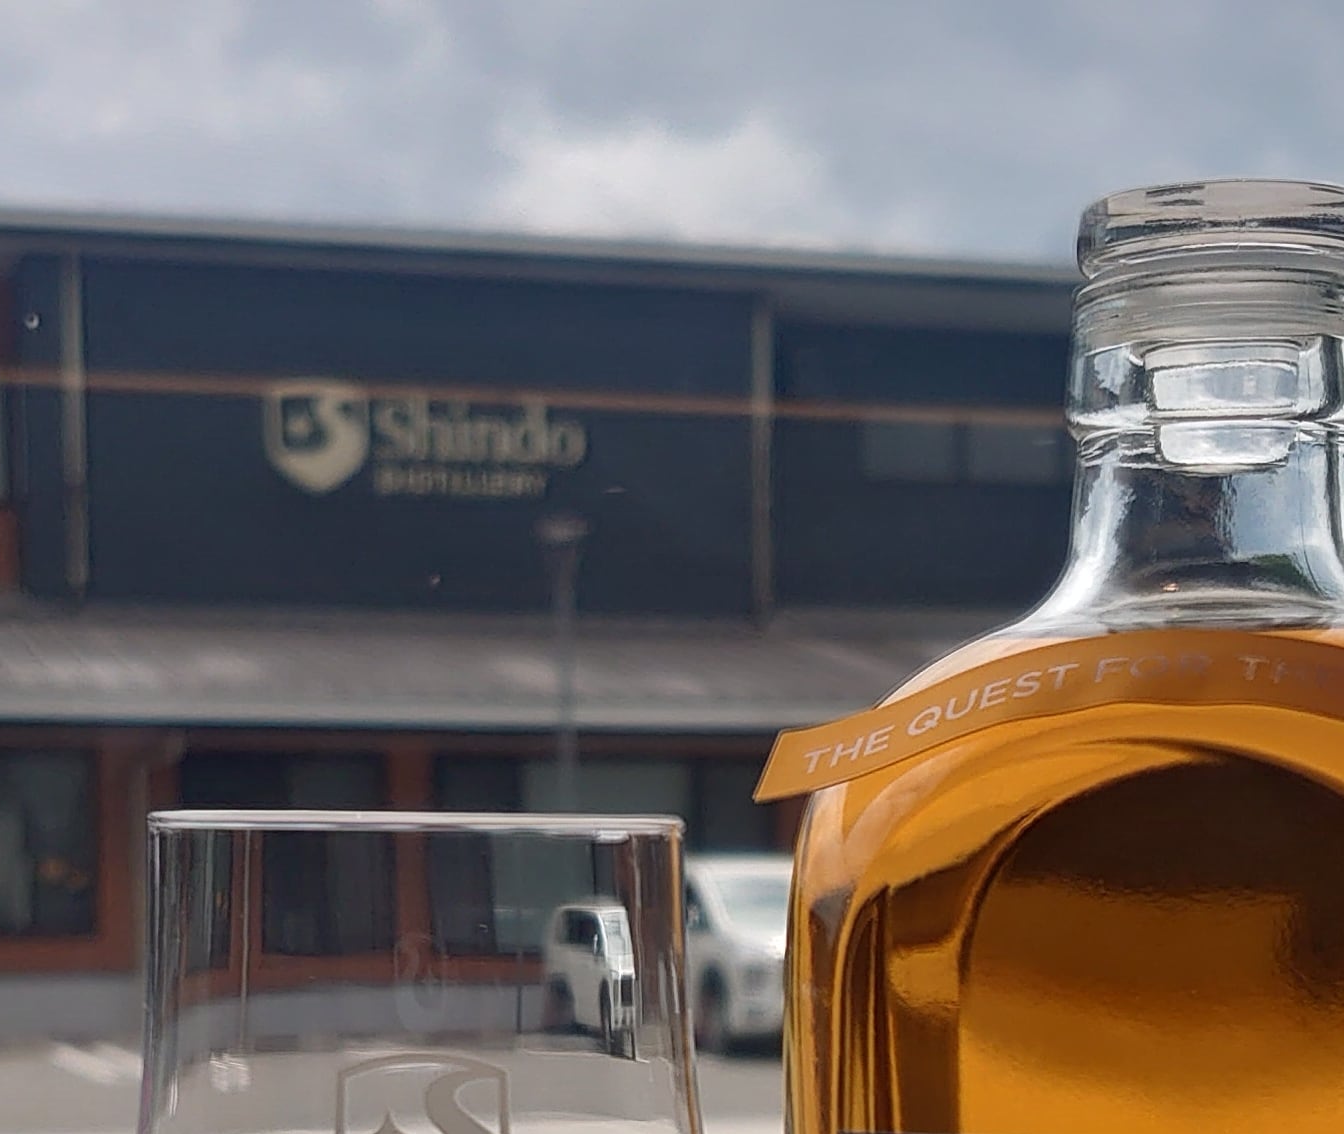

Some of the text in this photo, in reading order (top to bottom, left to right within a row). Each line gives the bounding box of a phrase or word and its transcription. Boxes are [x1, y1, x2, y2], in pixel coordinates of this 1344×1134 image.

[372, 393, 588, 467] Shindo
[803, 724, 894, 774] THE
[907, 663, 1080, 737] QUEST
[1094, 655, 1213, 684] FOR
